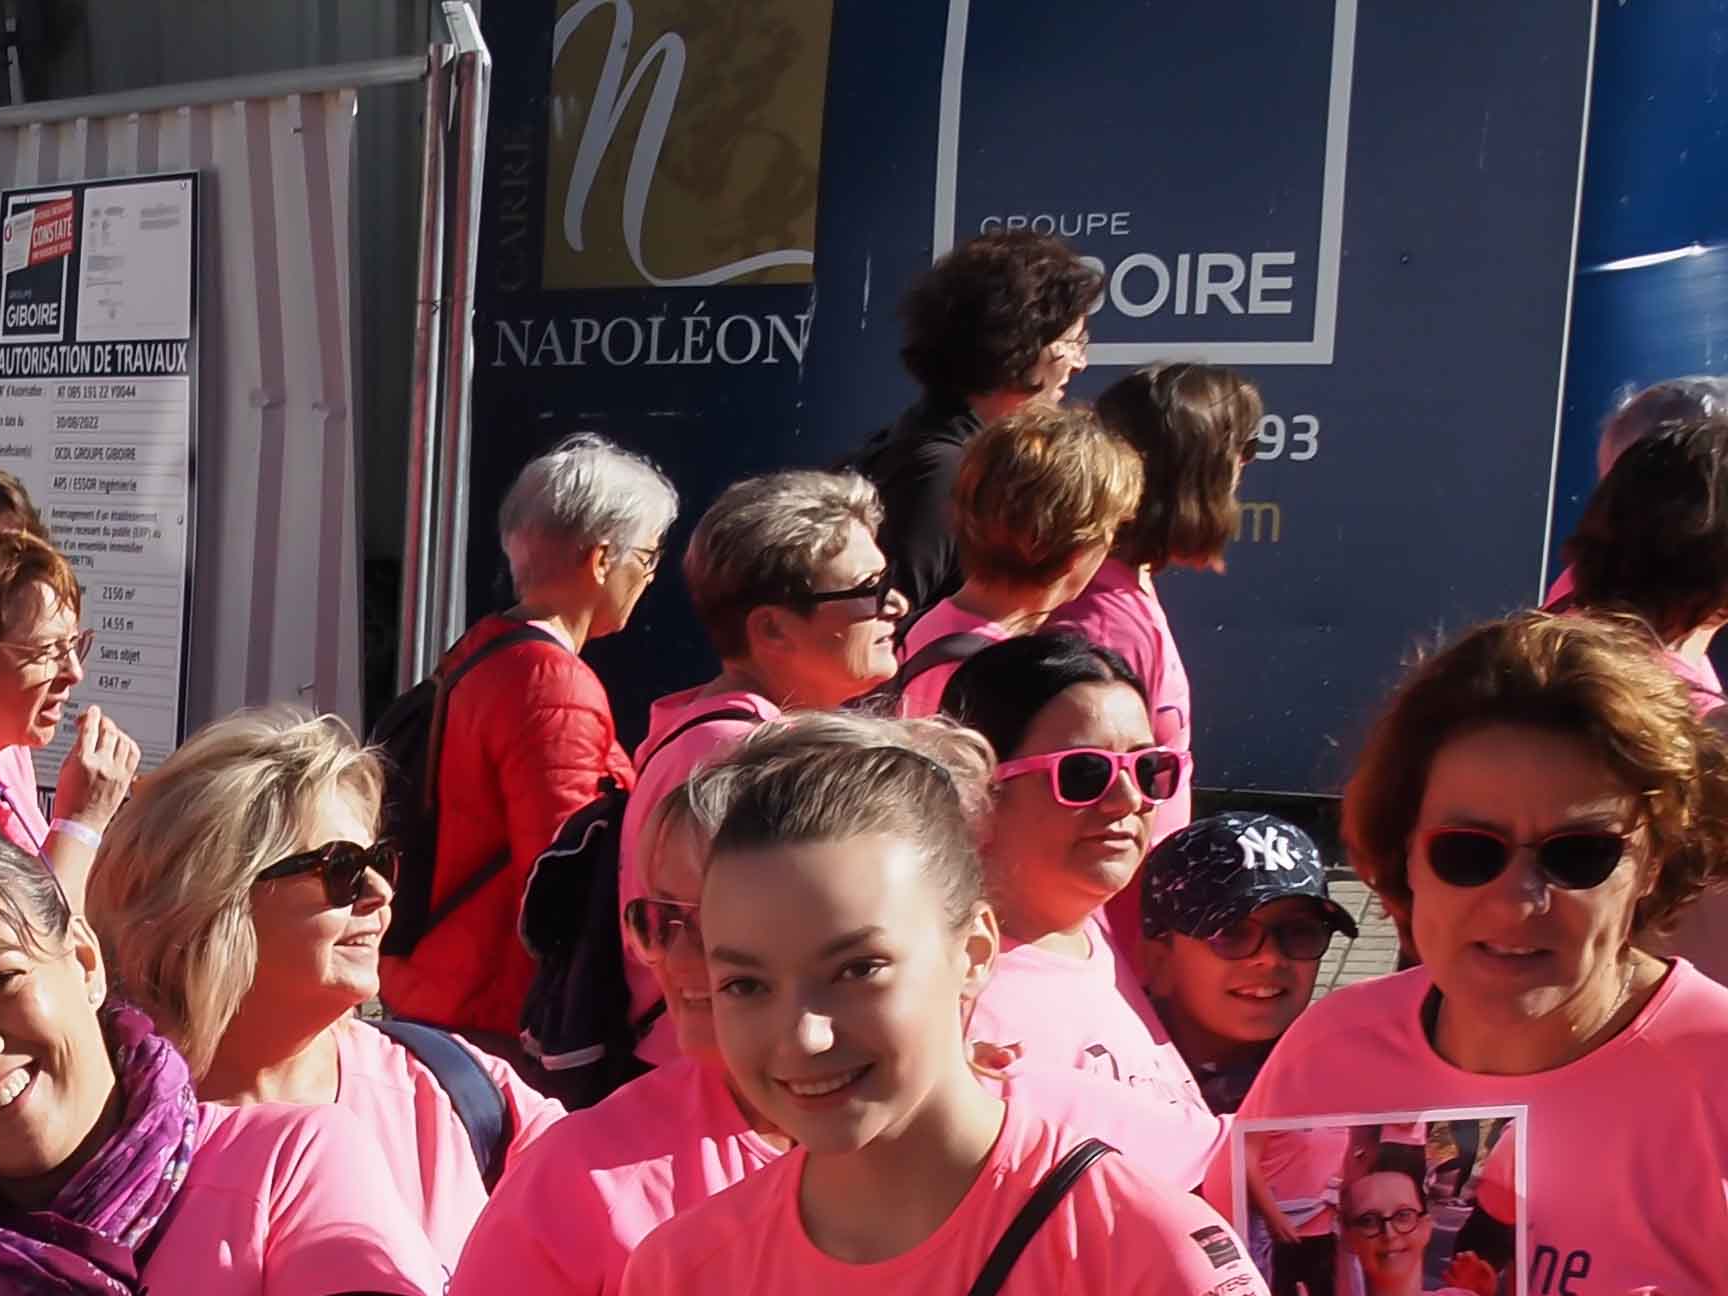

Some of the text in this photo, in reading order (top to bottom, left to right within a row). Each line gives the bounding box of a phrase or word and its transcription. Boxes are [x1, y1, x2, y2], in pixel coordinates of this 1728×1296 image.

[980, 212, 1131, 238] GROUPE
[6, 303, 58, 327] GIBOIRE
[491, 302, 812, 367] NAPOLÉON
[94, 345, 113, 373] DE
[115, 343, 188, 373] TRAVAUX
